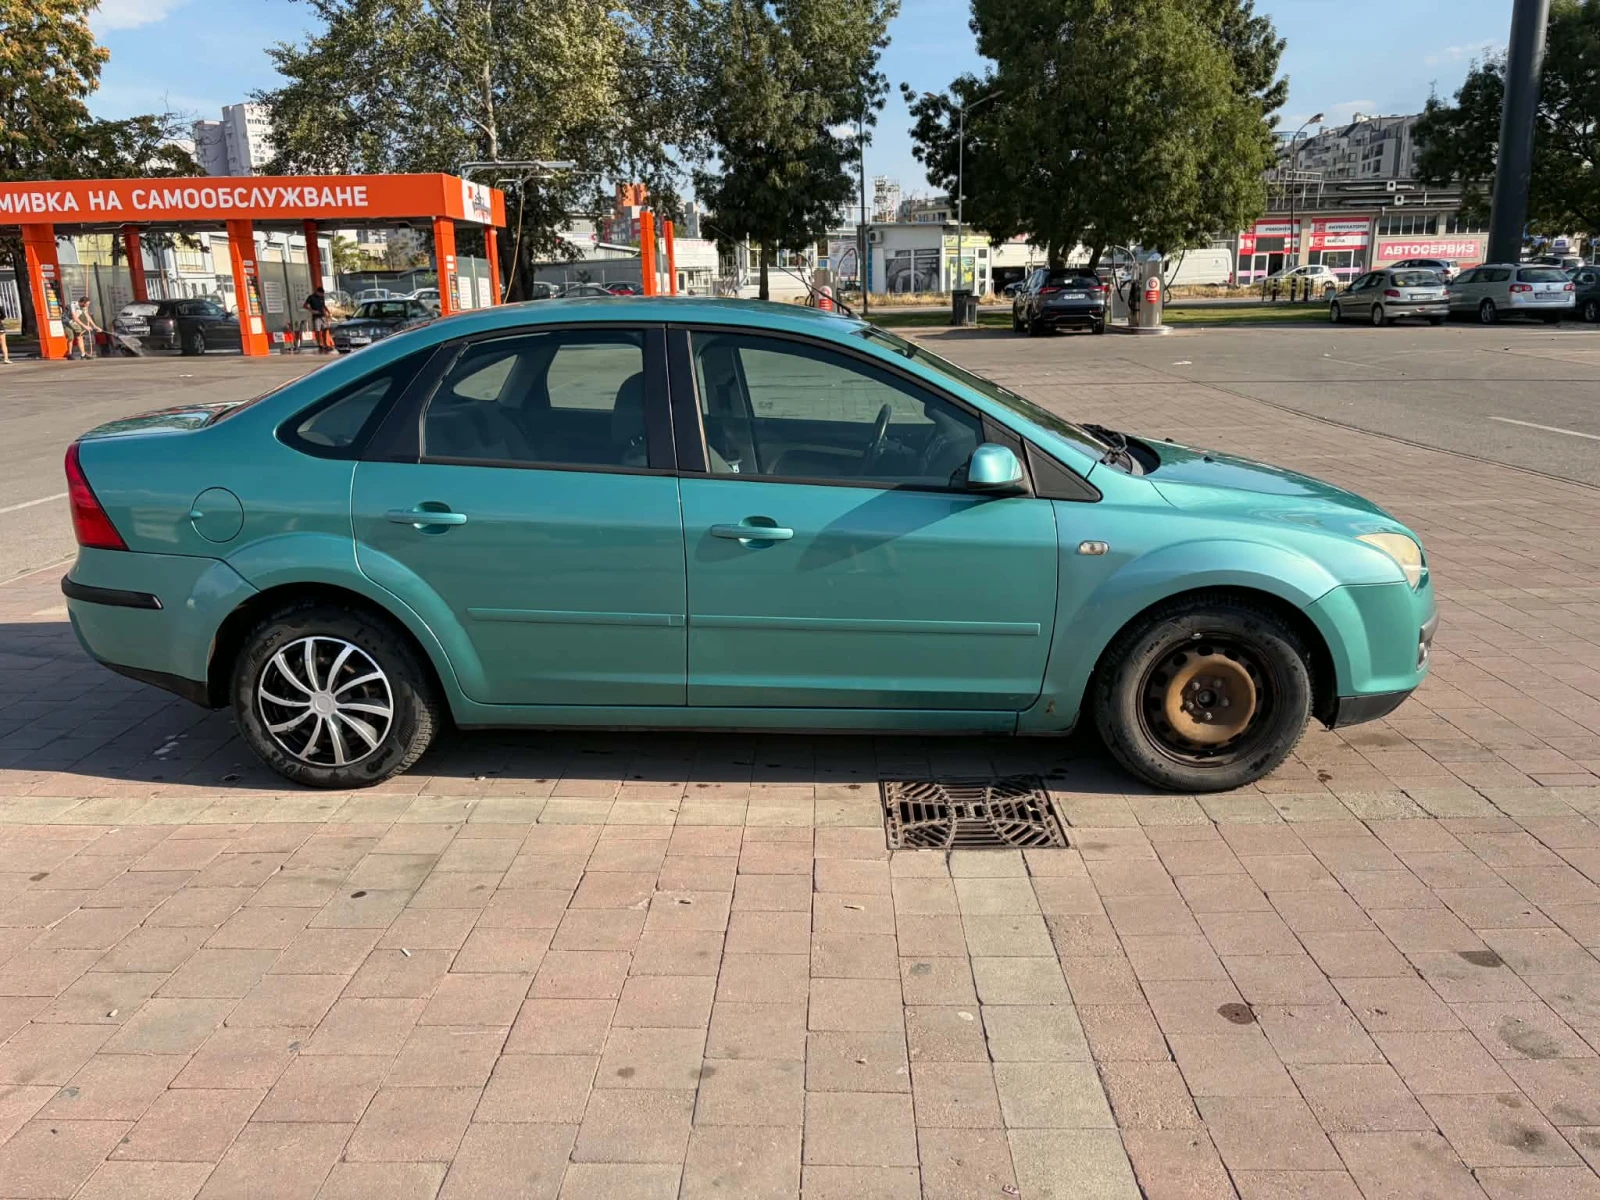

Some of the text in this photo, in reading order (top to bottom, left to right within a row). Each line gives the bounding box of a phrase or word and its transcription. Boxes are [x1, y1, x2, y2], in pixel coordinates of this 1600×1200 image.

[0, 186, 369, 213] МИВКА НА САМООБСЛУЖВАНЕ
[1384, 243, 1476, 256] АВТОСЕРВИЗ
